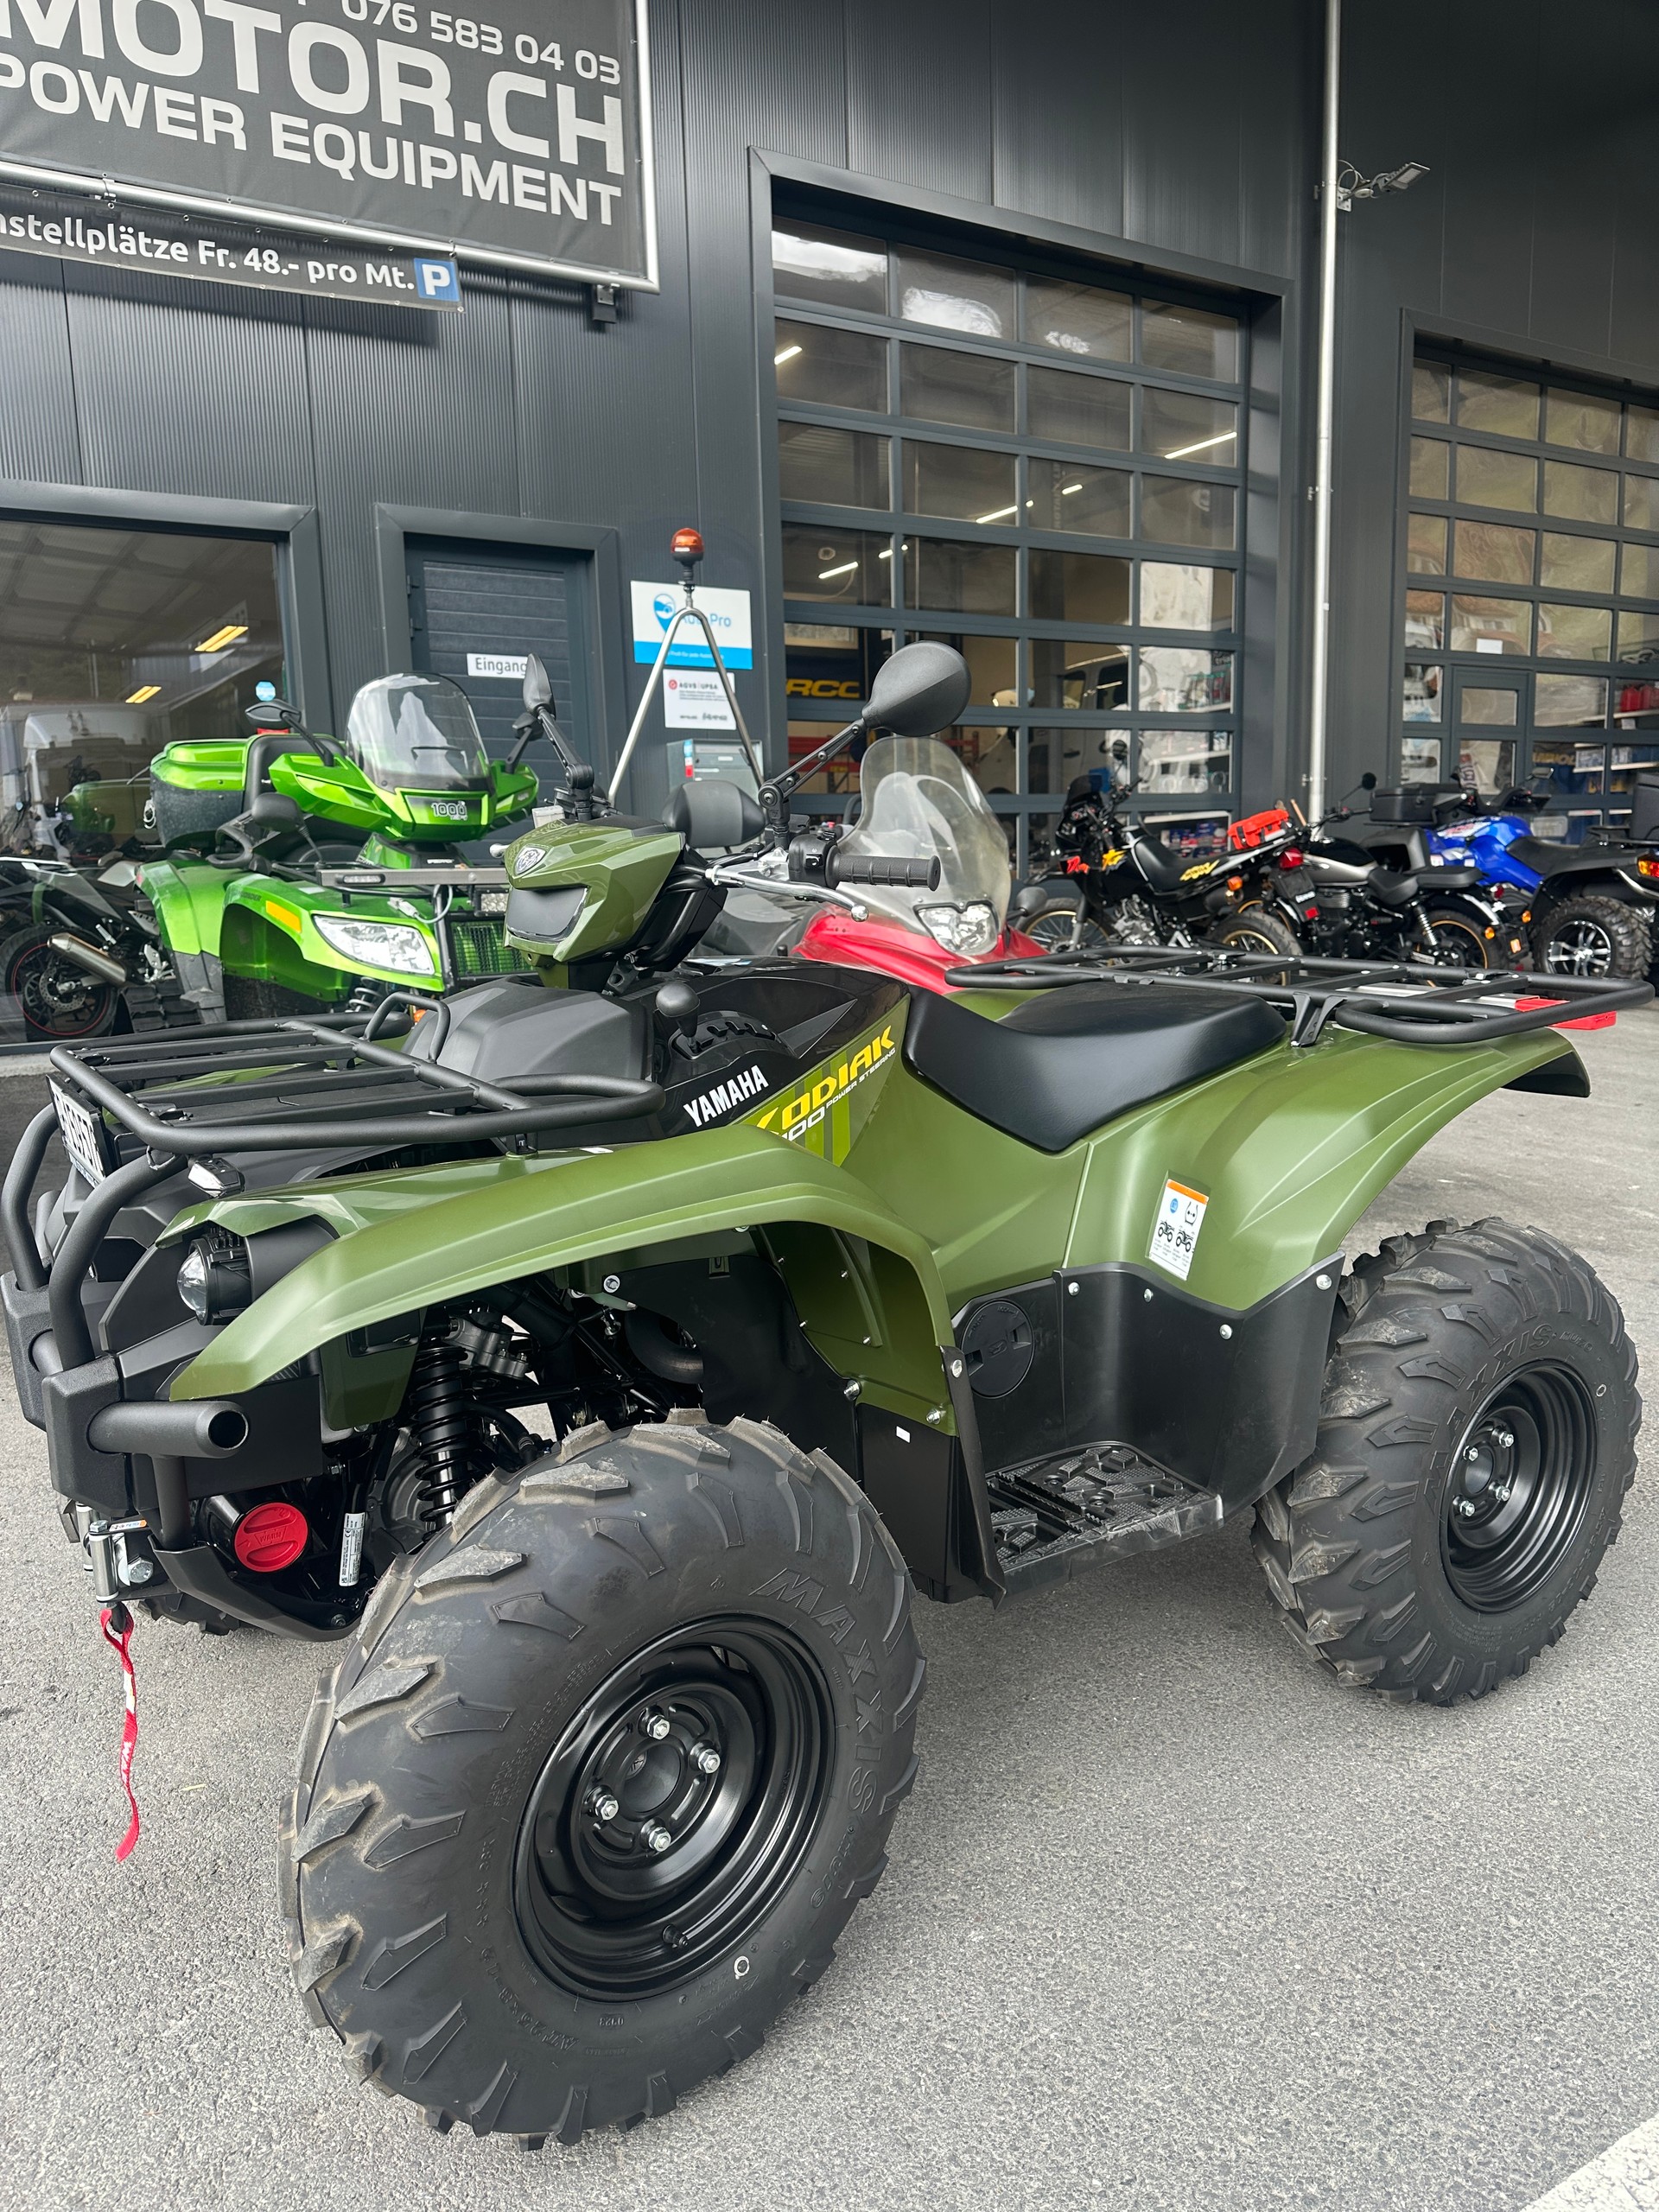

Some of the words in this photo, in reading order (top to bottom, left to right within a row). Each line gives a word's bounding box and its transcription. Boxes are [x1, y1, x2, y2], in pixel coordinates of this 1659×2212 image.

[0, 0, 625, 175] MOTOR.CH
[342, 0, 418, 33] 076
[430, 11, 504, 55] 583
[515, 34, 564, 71] 04
[575, 49, 620, 85] 03
[0, 52, 247, 151] POWER
[270, 111, 622, 226] EQUIPMENT
[198, 240, 237, 270] Fr.
[243, 247, 300, 275] 48.-
[308, 260, 358, 284] pro
[365, 262, 415, 290] Mt.
[423, 264, 449, 296] P
[683, 1065, 769, 1128] YAMAHA
[781, 1106, 826, 1141] 00
[825, 1081, 858, 1109] POWER
[858, 1047, 896, 1084] STEERING
[1423, 1323, 1554, 1516] MAXXIS
[748, 1567, 883, 1815] MAXXIS
